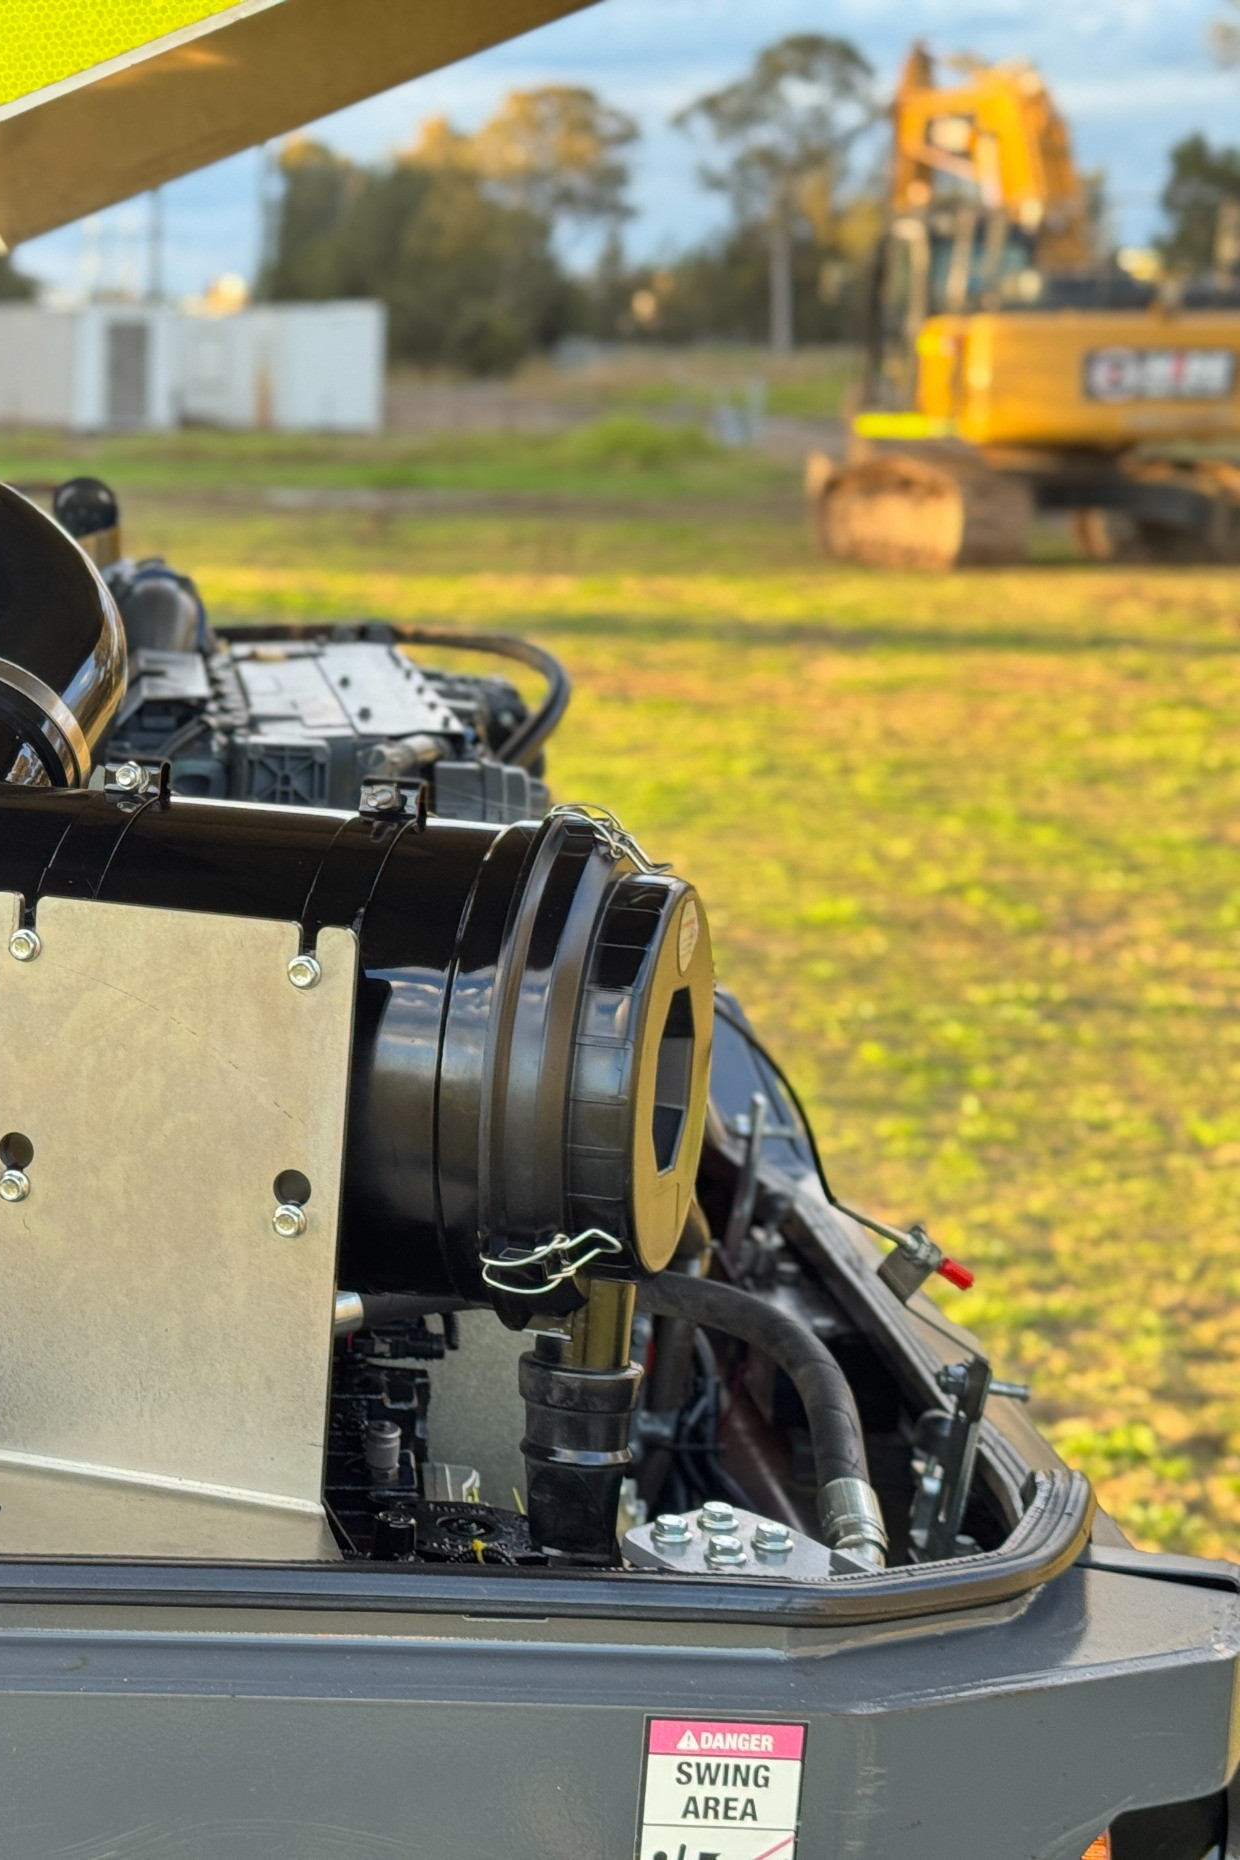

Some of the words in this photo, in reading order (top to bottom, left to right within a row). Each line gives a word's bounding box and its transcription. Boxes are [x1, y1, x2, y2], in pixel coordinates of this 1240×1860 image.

[700, 1731, 774, 1752] DANGER
[676, 1761, 771, 1788] SWING
[681, 1796, 758, 1821] AREA
